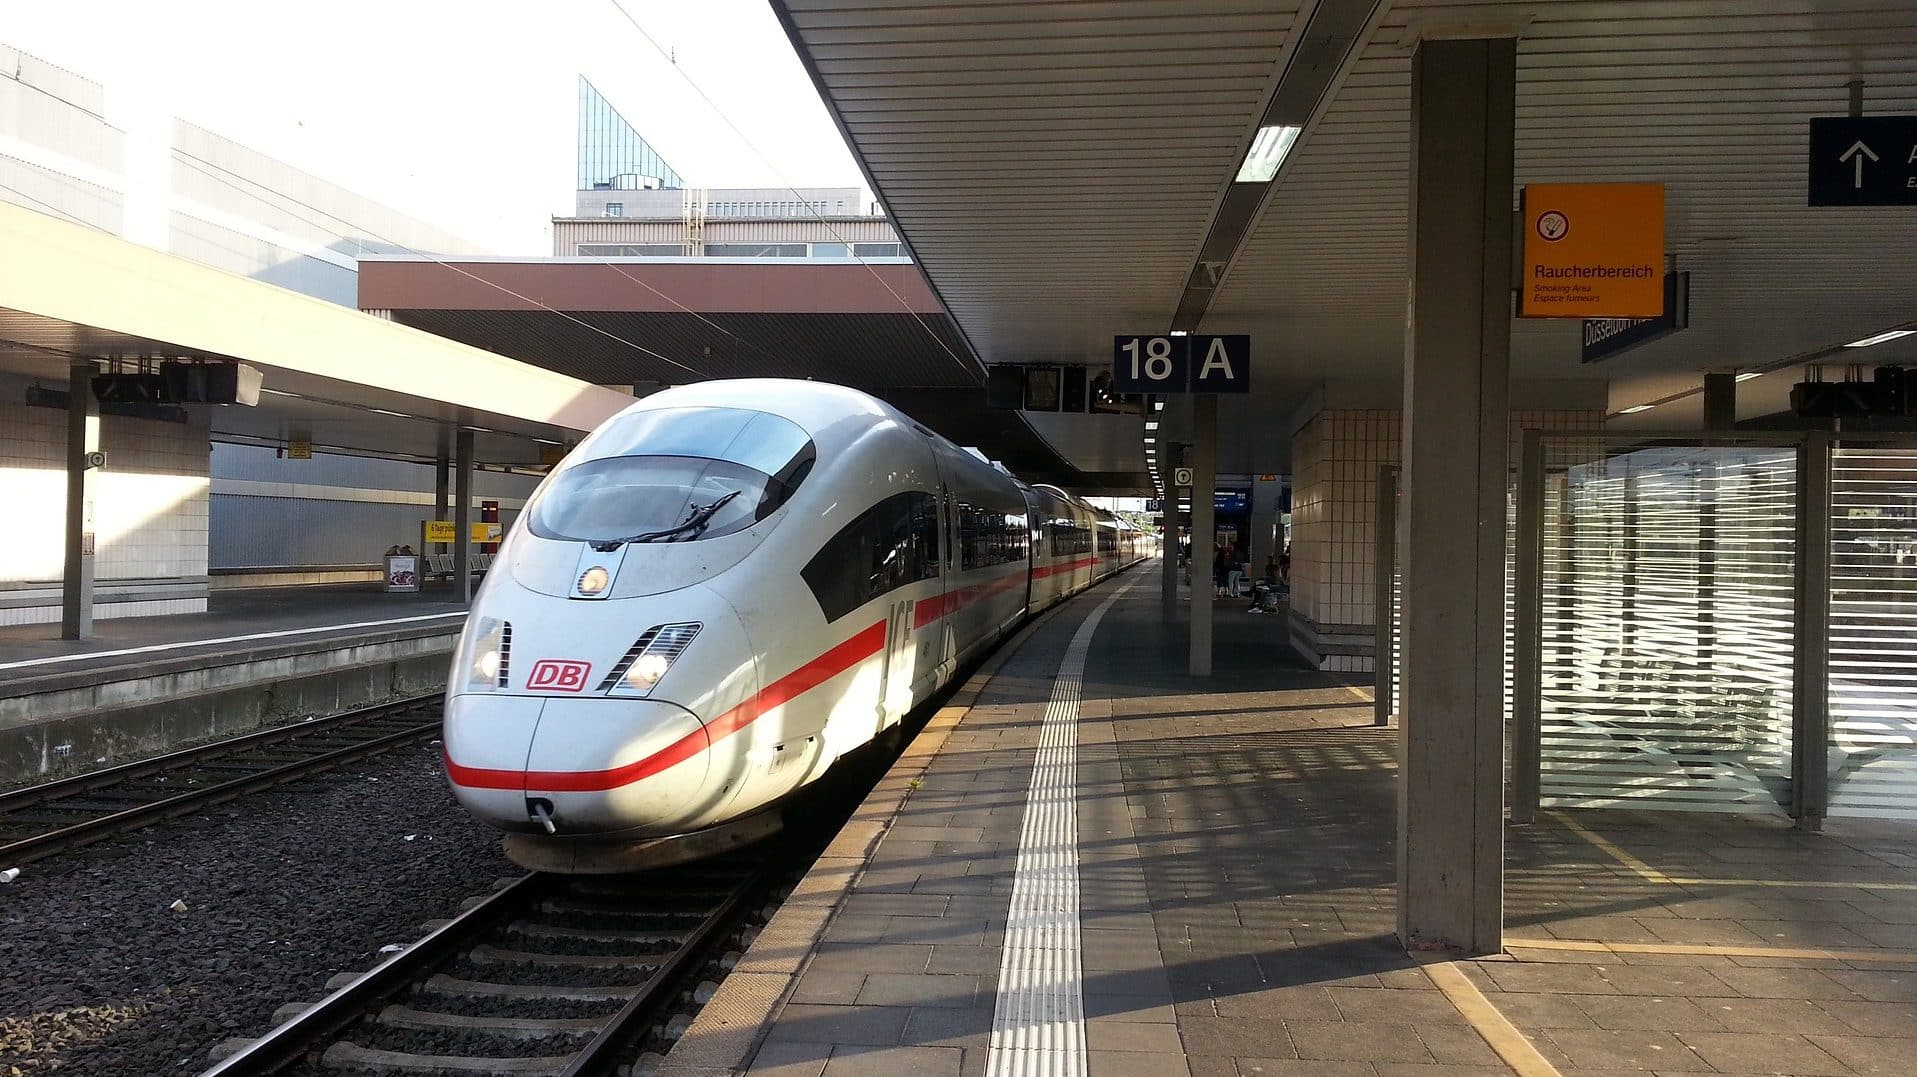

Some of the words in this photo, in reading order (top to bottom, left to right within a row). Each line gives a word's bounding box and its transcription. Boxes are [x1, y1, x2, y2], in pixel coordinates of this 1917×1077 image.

[1535, 264, 1654, 279] Raucherbereich
[1534, 284, 1570, 294] Smoking
[1571, 284, 1592, 293] Area
[1533, 294, 1564, 304] Espace
[1566, 294, 1601, 303] fumeurs
[1122, 337, 1173, 381] 18
[1198, 337, 1235, 380] A
[1146, 499, 1159, 511] 18
[535, 664, 581, 686] DB
